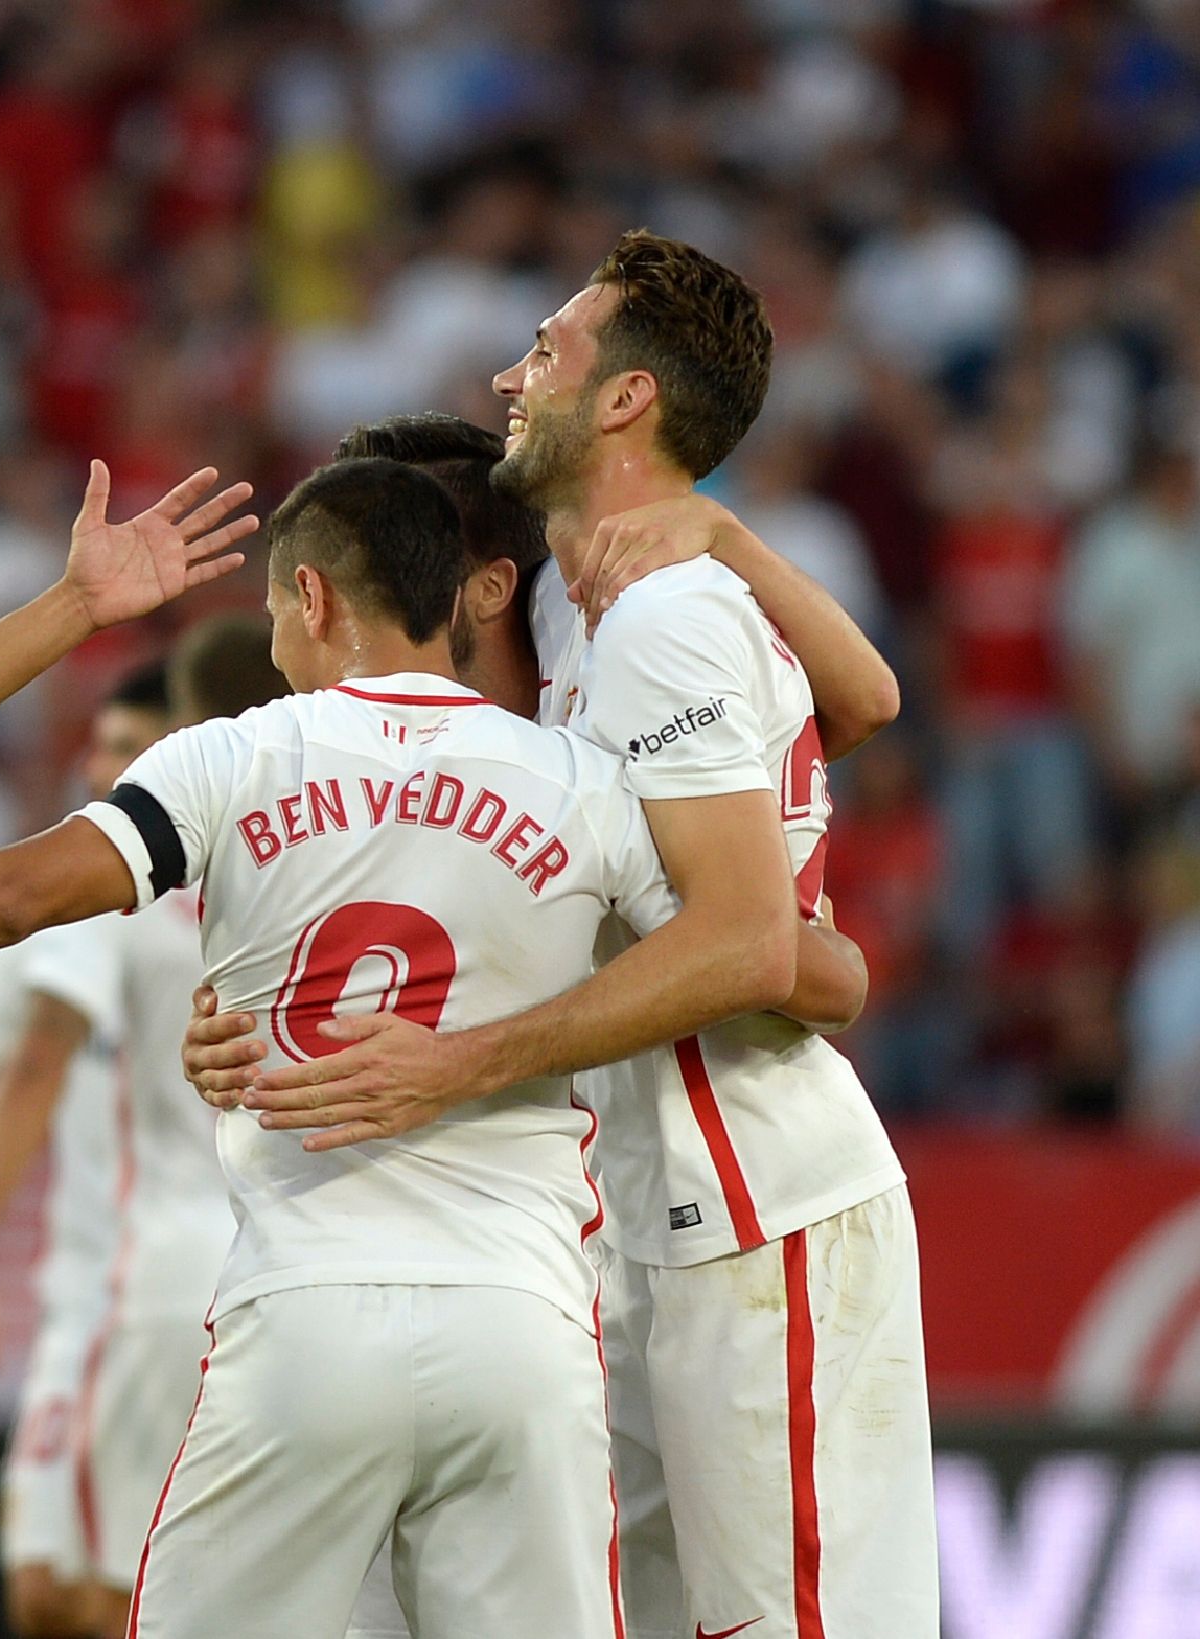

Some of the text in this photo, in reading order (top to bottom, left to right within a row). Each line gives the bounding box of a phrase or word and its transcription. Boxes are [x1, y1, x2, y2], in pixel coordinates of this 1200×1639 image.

[640, 697, 727, 755] betfair
[236, 771, 570, 897] BEN YEDDER
